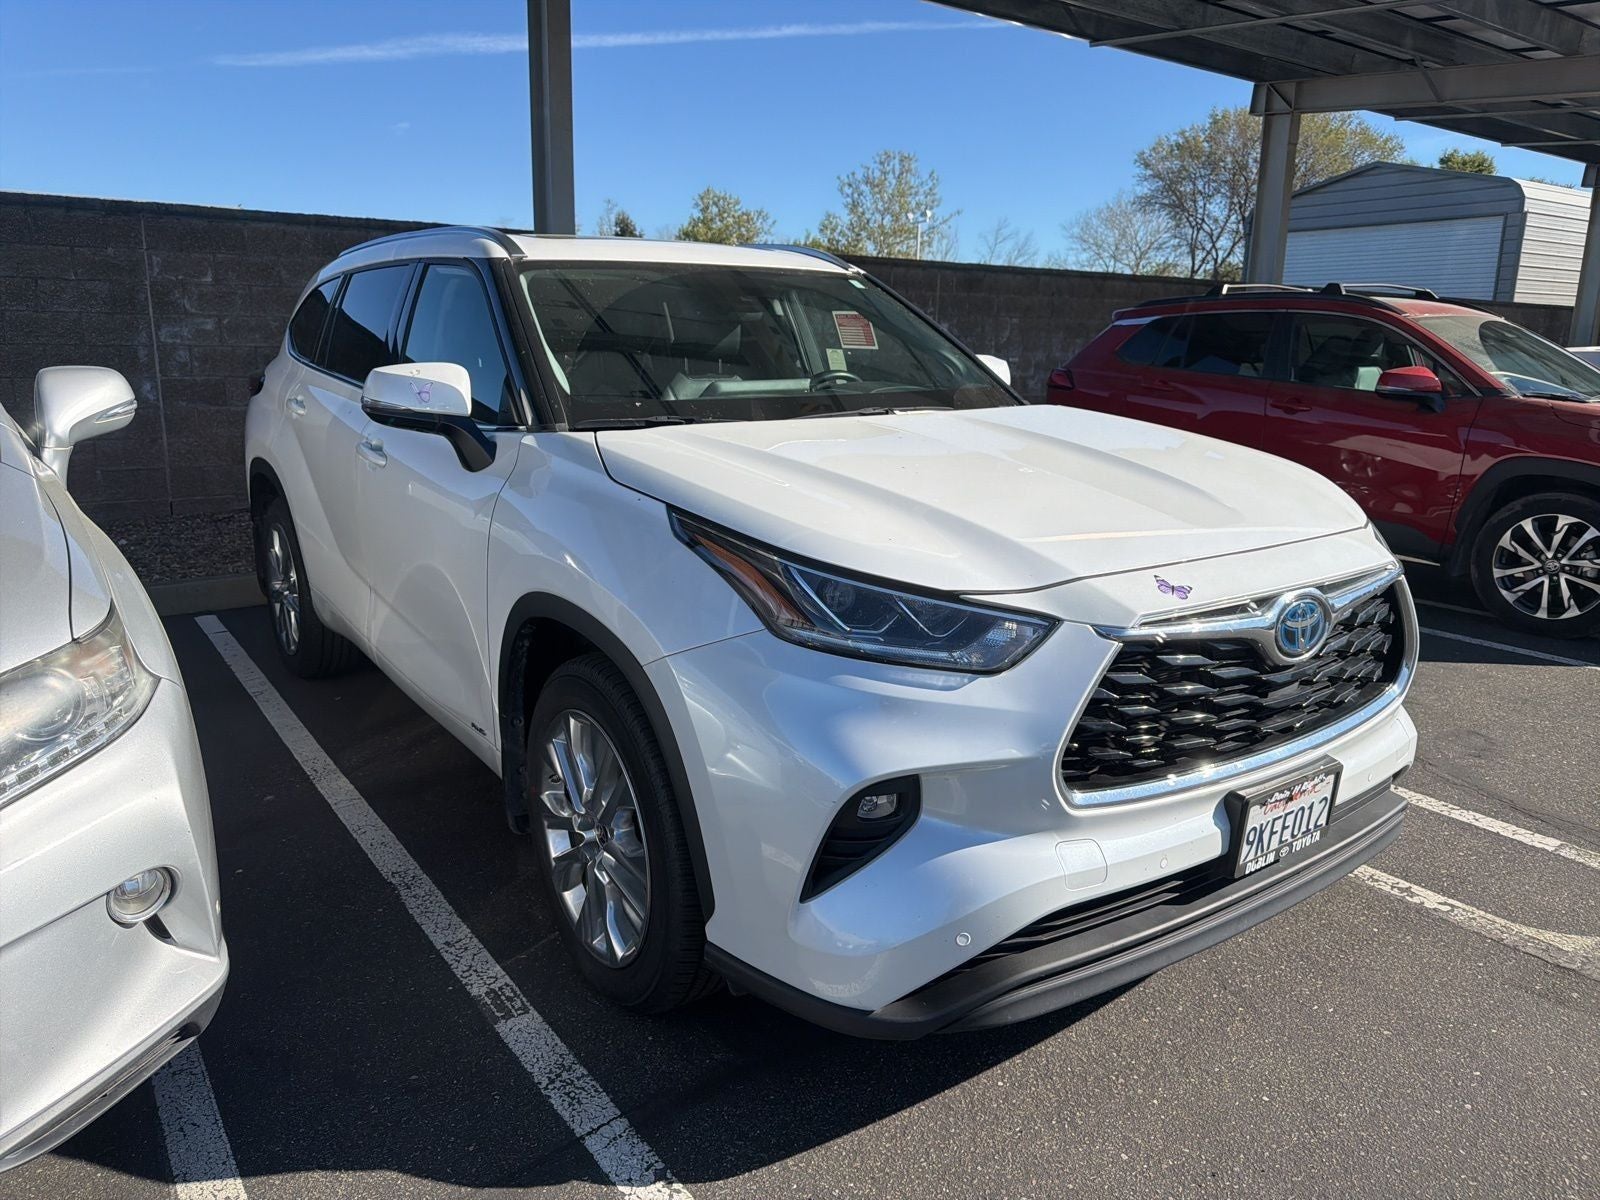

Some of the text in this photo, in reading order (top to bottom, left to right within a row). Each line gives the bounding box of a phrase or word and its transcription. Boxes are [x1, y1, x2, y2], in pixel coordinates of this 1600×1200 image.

[1242, 796, 1329, 862] 9KFE012
[1245, 830, 1321, 875] DUBLIN TOYOTA
